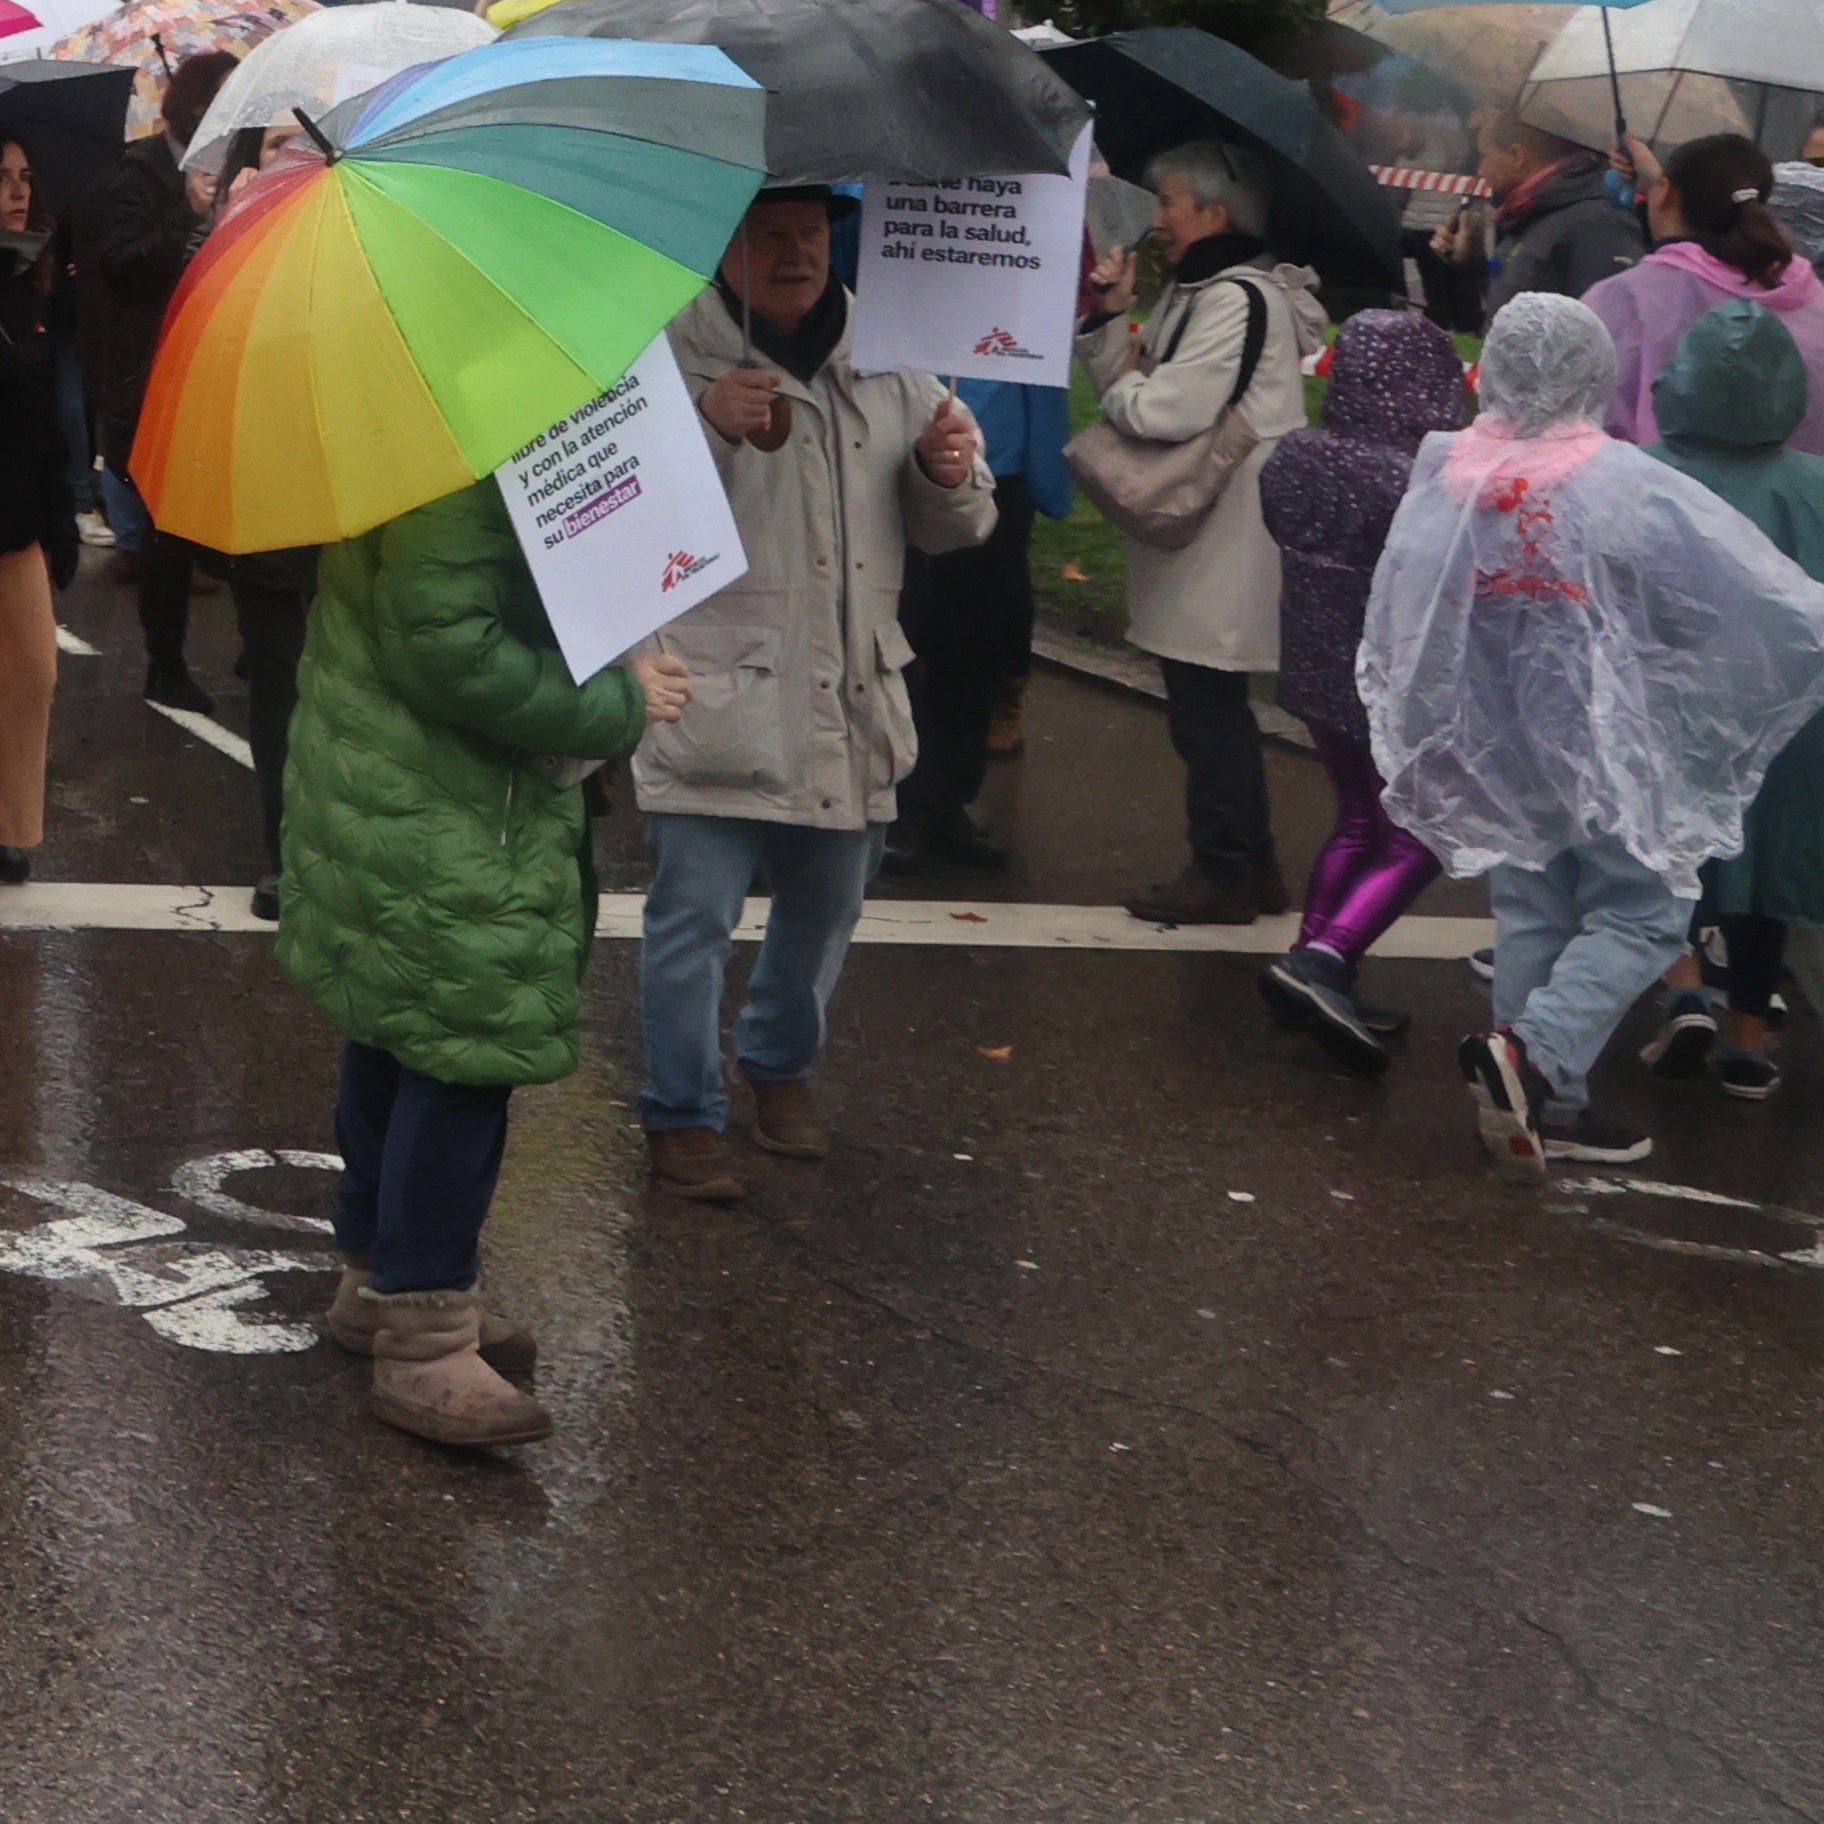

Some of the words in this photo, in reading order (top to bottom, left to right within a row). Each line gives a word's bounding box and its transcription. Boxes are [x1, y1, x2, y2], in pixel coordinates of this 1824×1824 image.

[886, 196, 927, 212] una
[934, 195, 1016, 219] barrera
[968, 177, 1022, 197] haya
[881, 241, 914, 259] ahí
[921, 246, 1041, 270] estaremos
[884, 220, 933, 238] para
[940, 219, 959, 239] la
[964, 223, 1031, 247] salud,
[518, 471, 531, 489] y
[532, 451, 562, 478] con
[561, 439, 580, 458] la
[581, 394, 649, 447] atención
[527, 464, 587, 507] médica
[588, 440, 619, 470] que
[535, 479, 603, 528] necesita
[604, 454, 641, 489] para
[543, 528, 565, 550] su
[562, 478, 639, 536] bienestar
